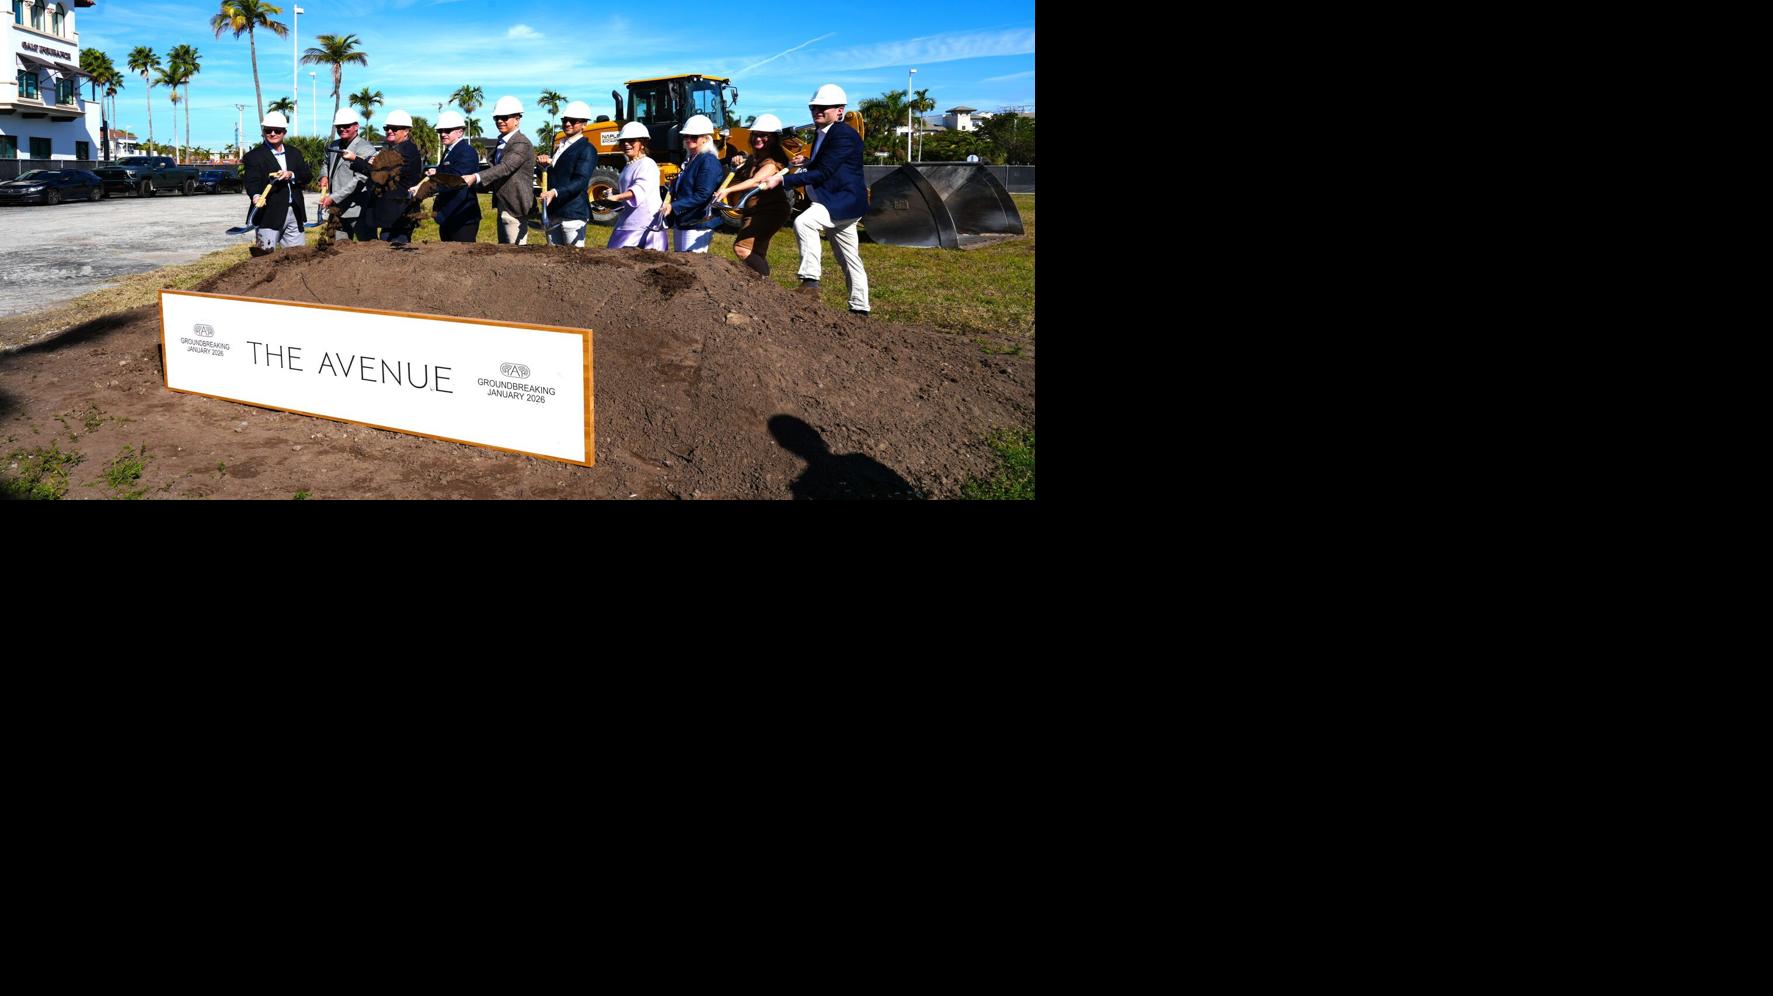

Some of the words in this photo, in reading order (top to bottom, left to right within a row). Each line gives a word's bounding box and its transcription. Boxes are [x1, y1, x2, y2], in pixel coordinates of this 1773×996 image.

[39, 45, 71, 61] INSURANCE
[181, 338, 230, 351] GROUNDBREAKING
[187, 346, 211, 355] JANUARY
[211, 349, 224, 357] 2026
[247, 341, 303, 371] THE
[319, 352, 453, 393] AVENUE
[478, 378, 556, 395] GROUNDBREAKING
[487, 388, 525, 400] JANUARY
[526, 394, 546, 403] 2026
